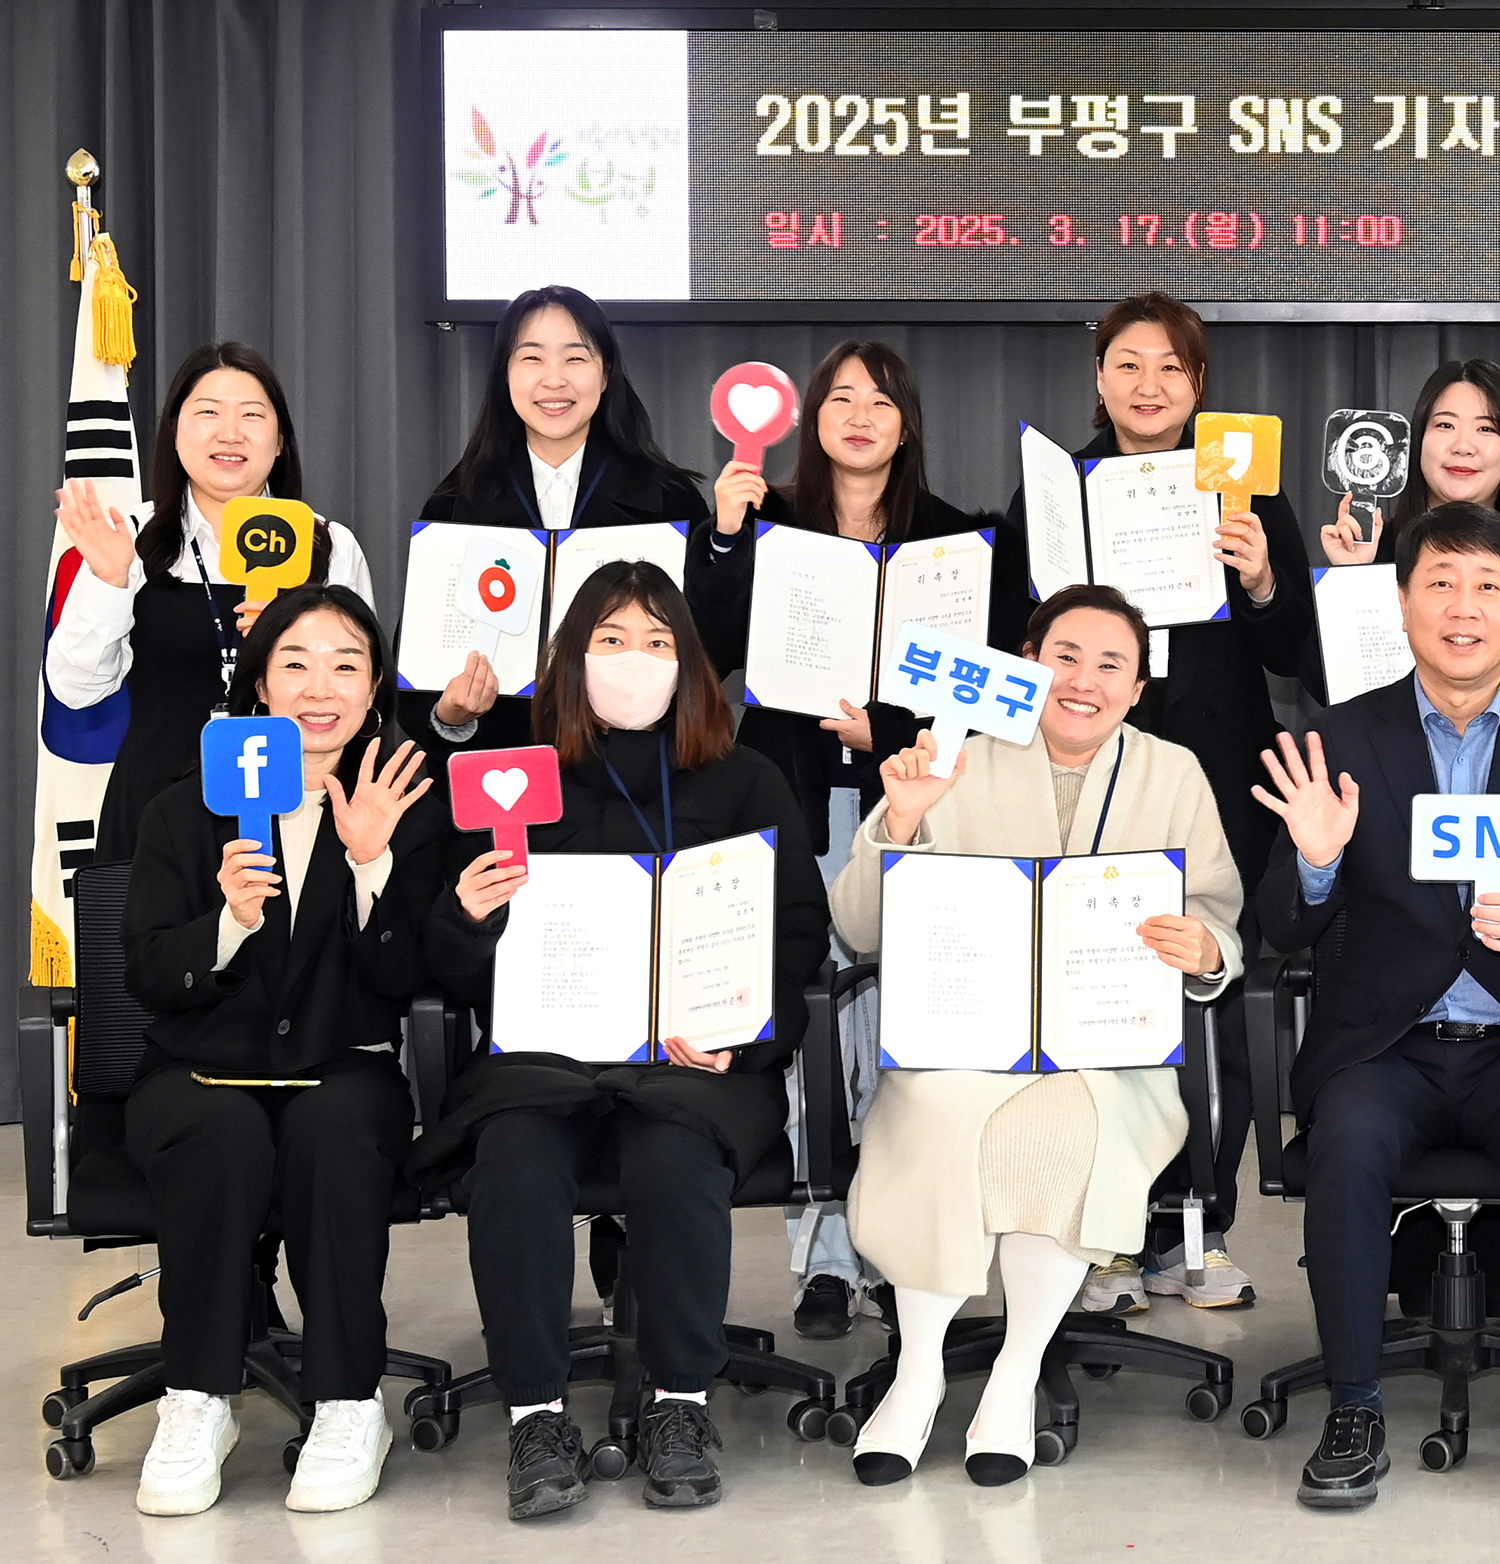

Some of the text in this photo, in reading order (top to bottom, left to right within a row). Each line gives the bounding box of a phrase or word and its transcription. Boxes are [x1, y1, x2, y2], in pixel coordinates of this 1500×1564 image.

[755, 93, 971, 157] 2025년
[1006, 94, 1199, 160] 부평구
[1228, 95, 1344, 154] SNS
[765, 212, 842, 249] 일시
[915, 214, 1020, 247] 2025.
[1049, 214, 1087, 247] 3.
[1293, 214, 1403, 247] 11:00
[244, 528, 287, 555] Ch
[897, 641, 1038, 719] 부평구
